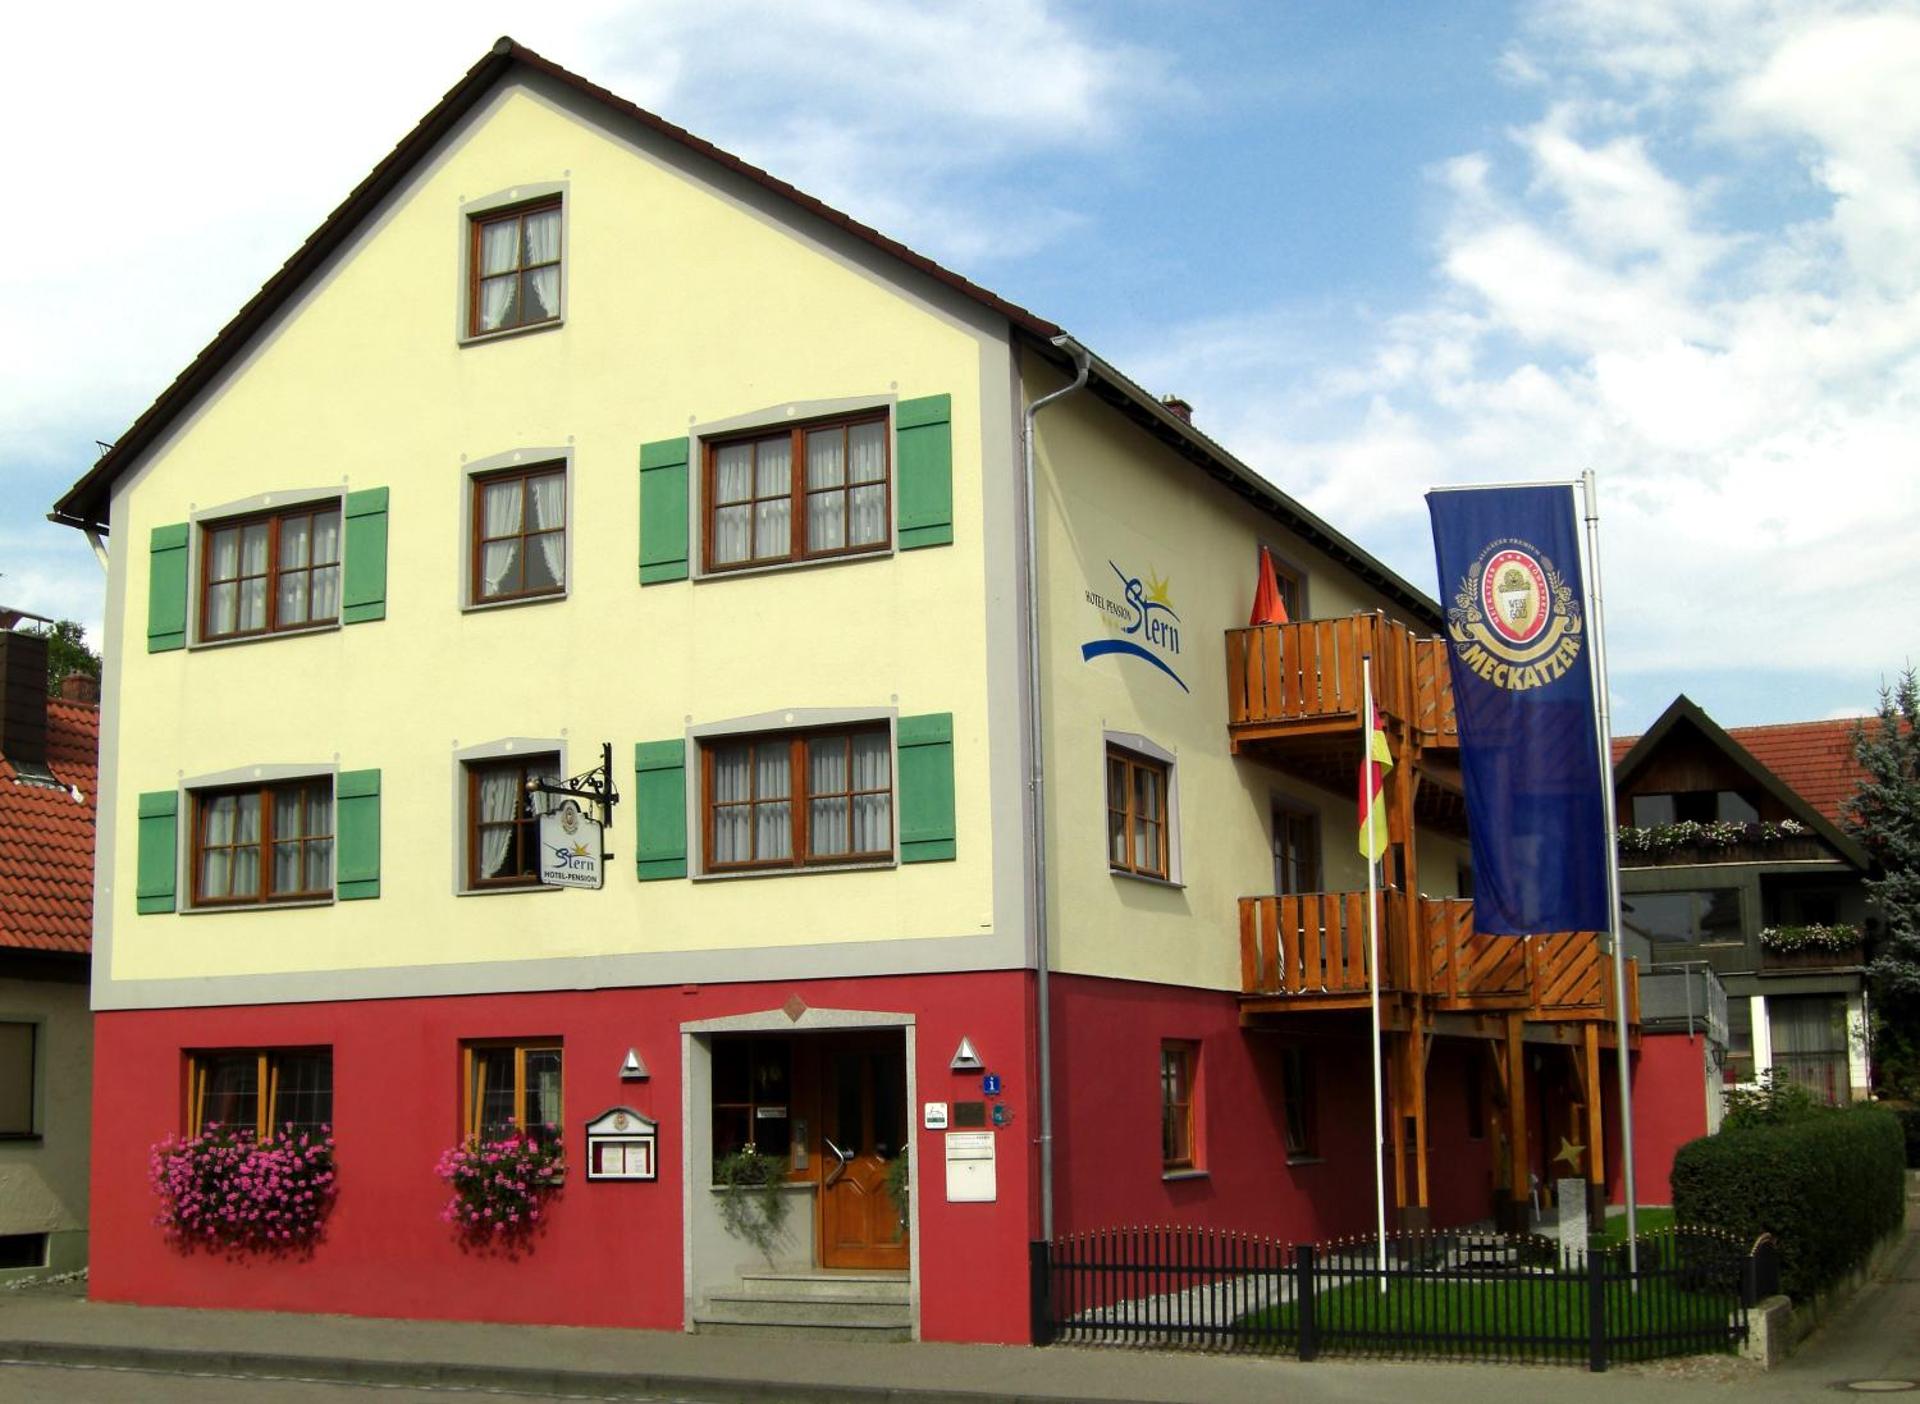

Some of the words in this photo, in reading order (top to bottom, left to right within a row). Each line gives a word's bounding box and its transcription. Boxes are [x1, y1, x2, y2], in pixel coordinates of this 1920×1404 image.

[1085, 591, 1105, 610] HOTEL
[1106, 600, 1132, 621] PENSION
[1119, 576, 1180, 654] Stern
[1463, 637, 1580, 690] MECKATZER
[553, 848, 594, 871] Stern
[544, 871, 597, 882] HOTEL-PENSION
